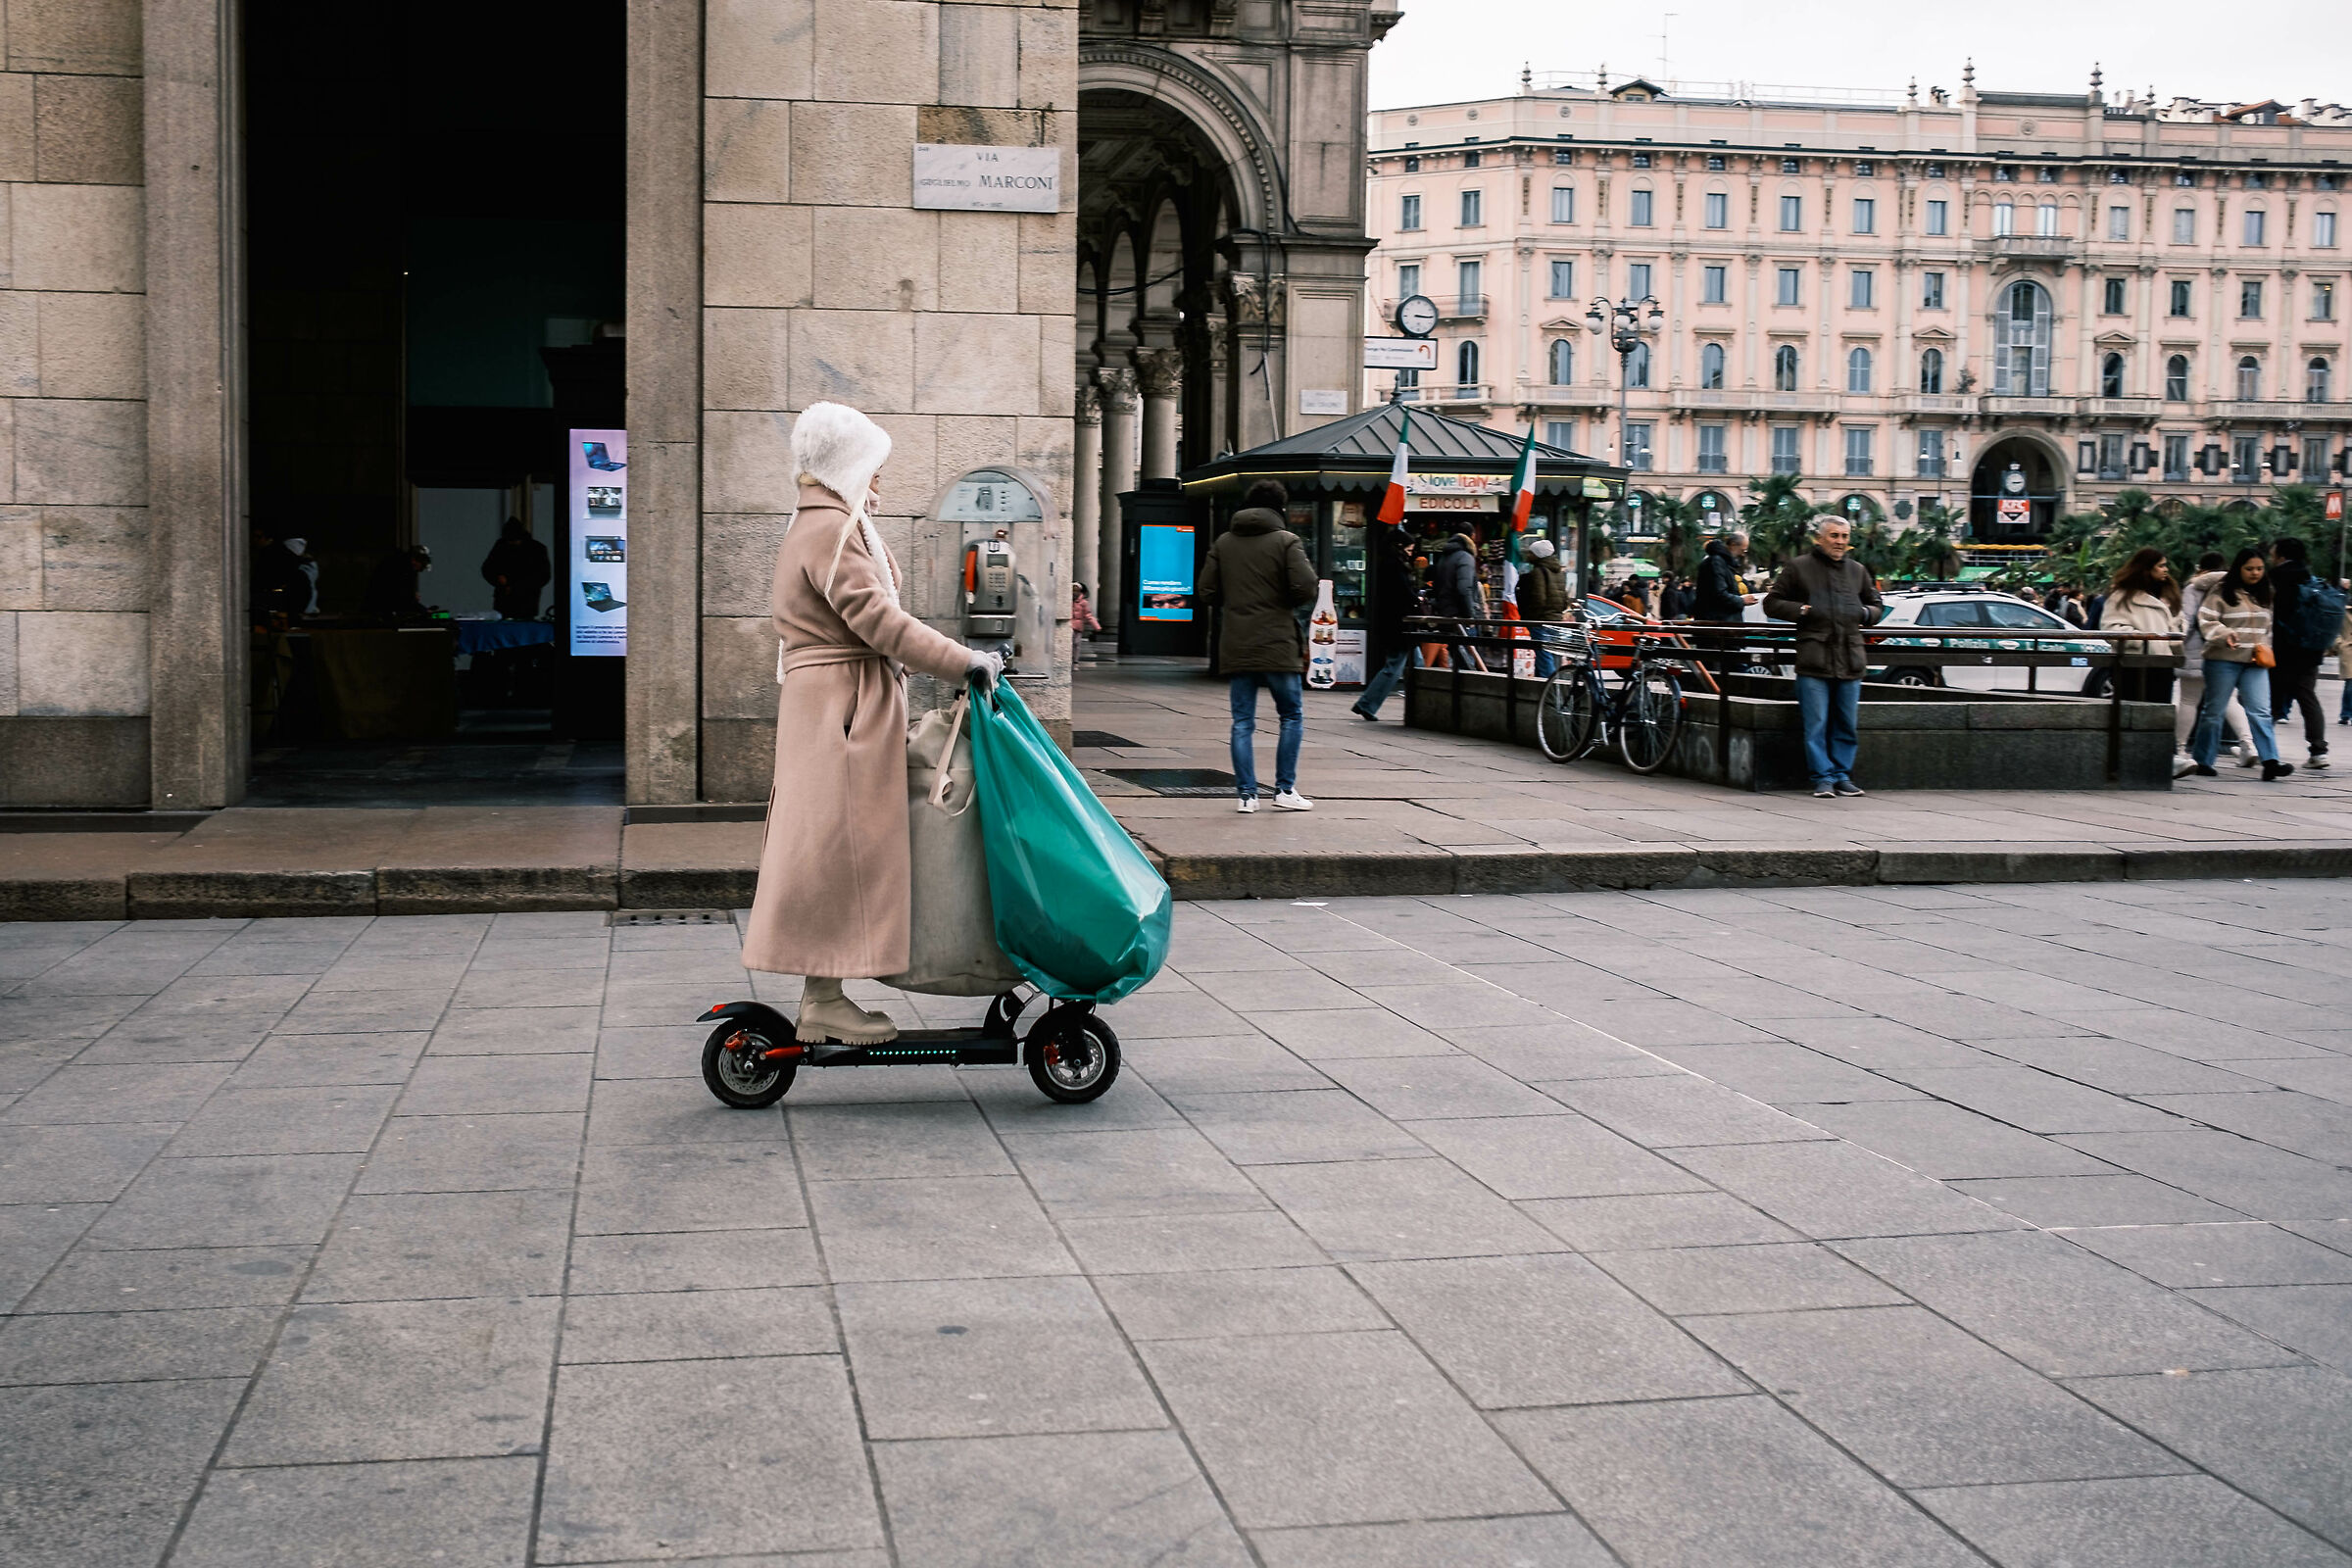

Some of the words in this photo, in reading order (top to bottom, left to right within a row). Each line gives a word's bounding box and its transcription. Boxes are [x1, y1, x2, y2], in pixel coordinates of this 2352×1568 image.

[976, 152, 1000, 163] VIA
[979, 174, 1054, 190] MARCONI
[1419, 497, 1482, 510] EDICOLA
[2002, 500, 2026, 512] KFC
[1948, 638, 1989, 648] Polizia
[2025, 641, 2066, 651] Lcale
